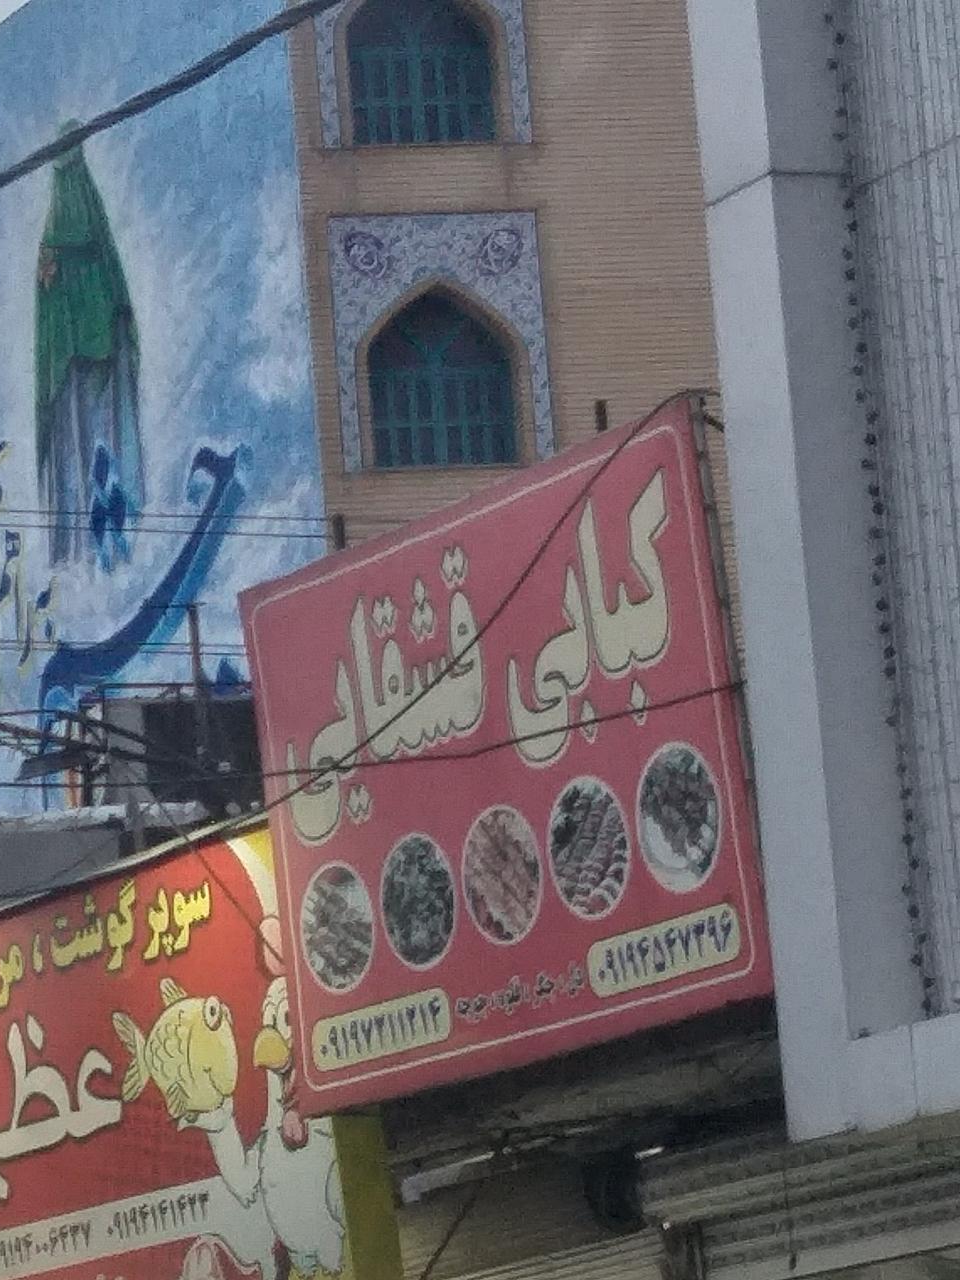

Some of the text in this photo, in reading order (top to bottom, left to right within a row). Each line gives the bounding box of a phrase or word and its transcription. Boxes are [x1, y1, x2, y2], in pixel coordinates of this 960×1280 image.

[284, 545, 486, 847] قشقایی
[507, 466, 671, 766] کبابی
[48, 875, 139, 972] گوشت
[142, 880, 213, 962] سوپر
